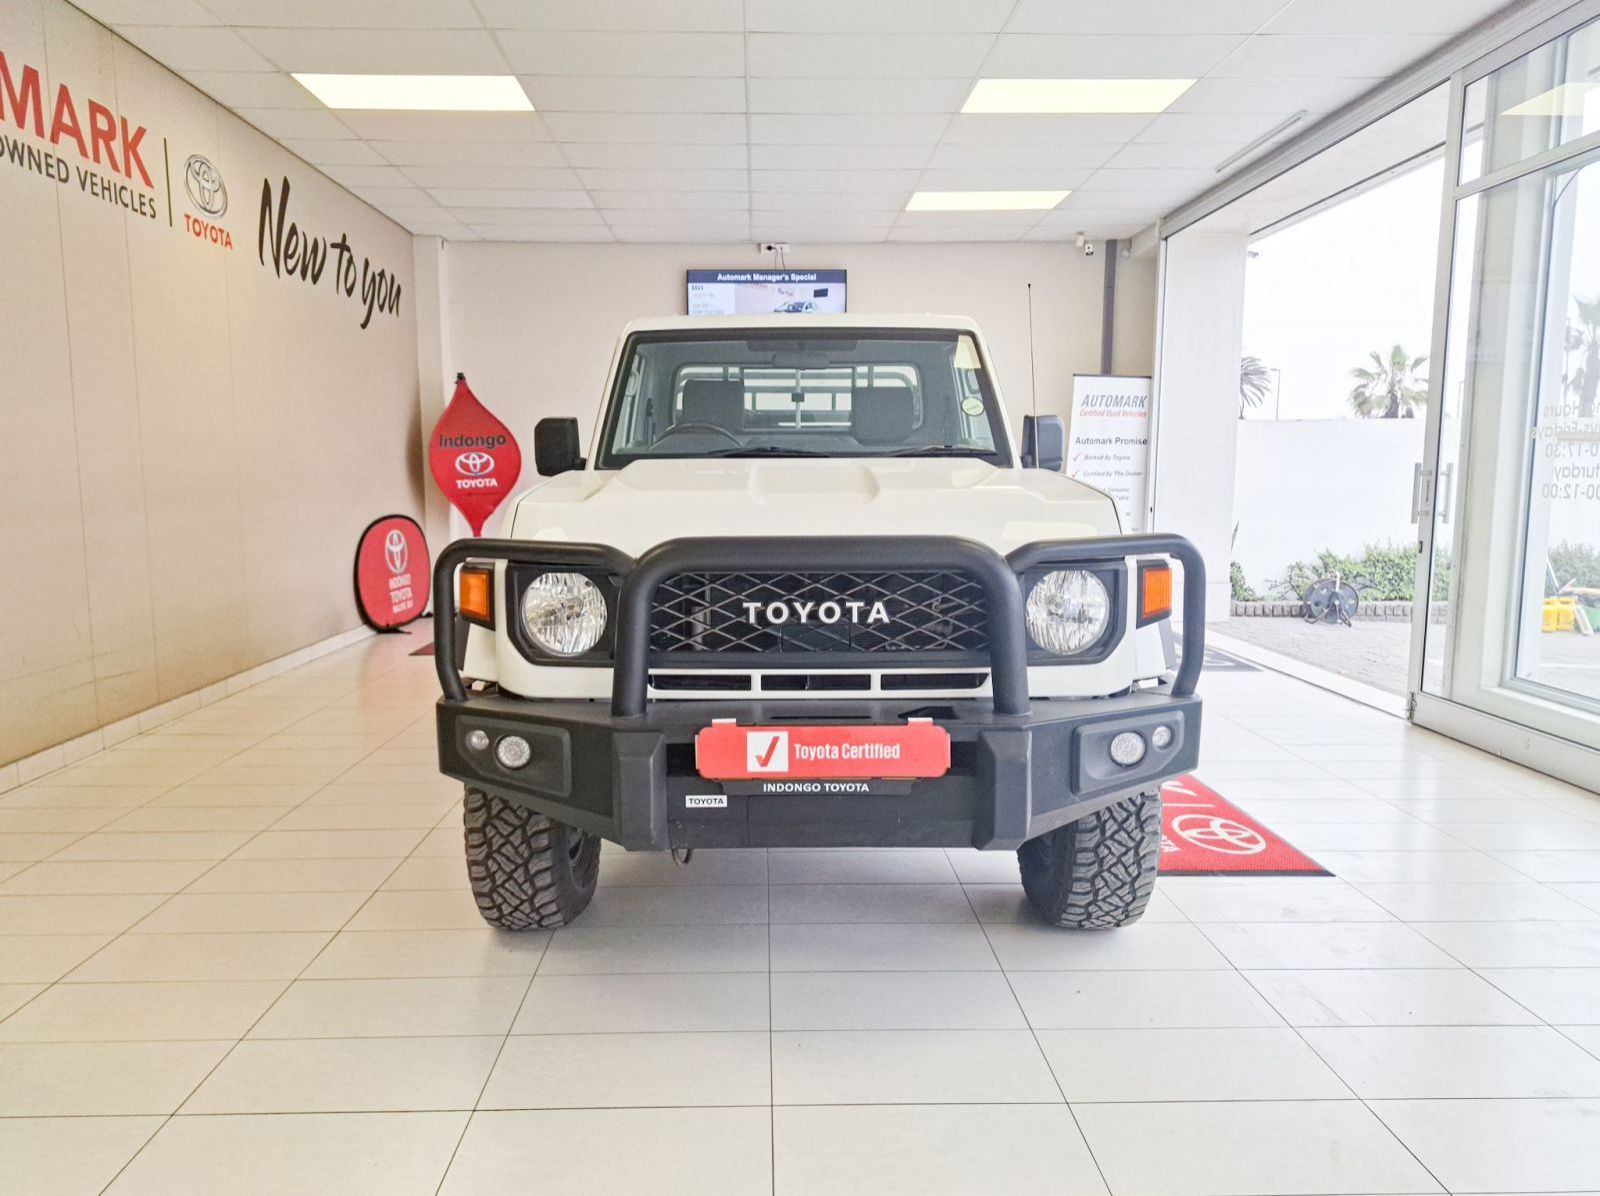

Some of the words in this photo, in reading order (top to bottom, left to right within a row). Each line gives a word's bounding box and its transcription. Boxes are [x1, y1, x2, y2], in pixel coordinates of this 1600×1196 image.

[76, 165, 157, 219] VEHICLES
[184, 213, 233, 250] TOYOTA
[258, 175, 327, 285] New
[330, 232, 357, 298] to
[360, 257, 401, 330] you
[717, 273, 752, 281] Automark
[753, 273, 789, 282] Manager's
[791, 273, 816, 282] Special
[1080, 394, 1148, 408] AUTOMARK
[1080, 409, 1106, 417] Certified
[439, 434, 507, 449] Indongo
[1075, 437, 1112, 445] Automark
[1115, 437, 1148, 445] Promise
[456, 477, 498, 489] TOYOTA
[743, 602, 890, 624] TOYOTA
[794, 743, 839, 761] Toyota
[841, 743, 900, 759] Certified
[763, 783, 821, 792] INDONGO
[824, 783, 869, 792] TOYOTA
[689, 798, 724, 806] TOYOTA
